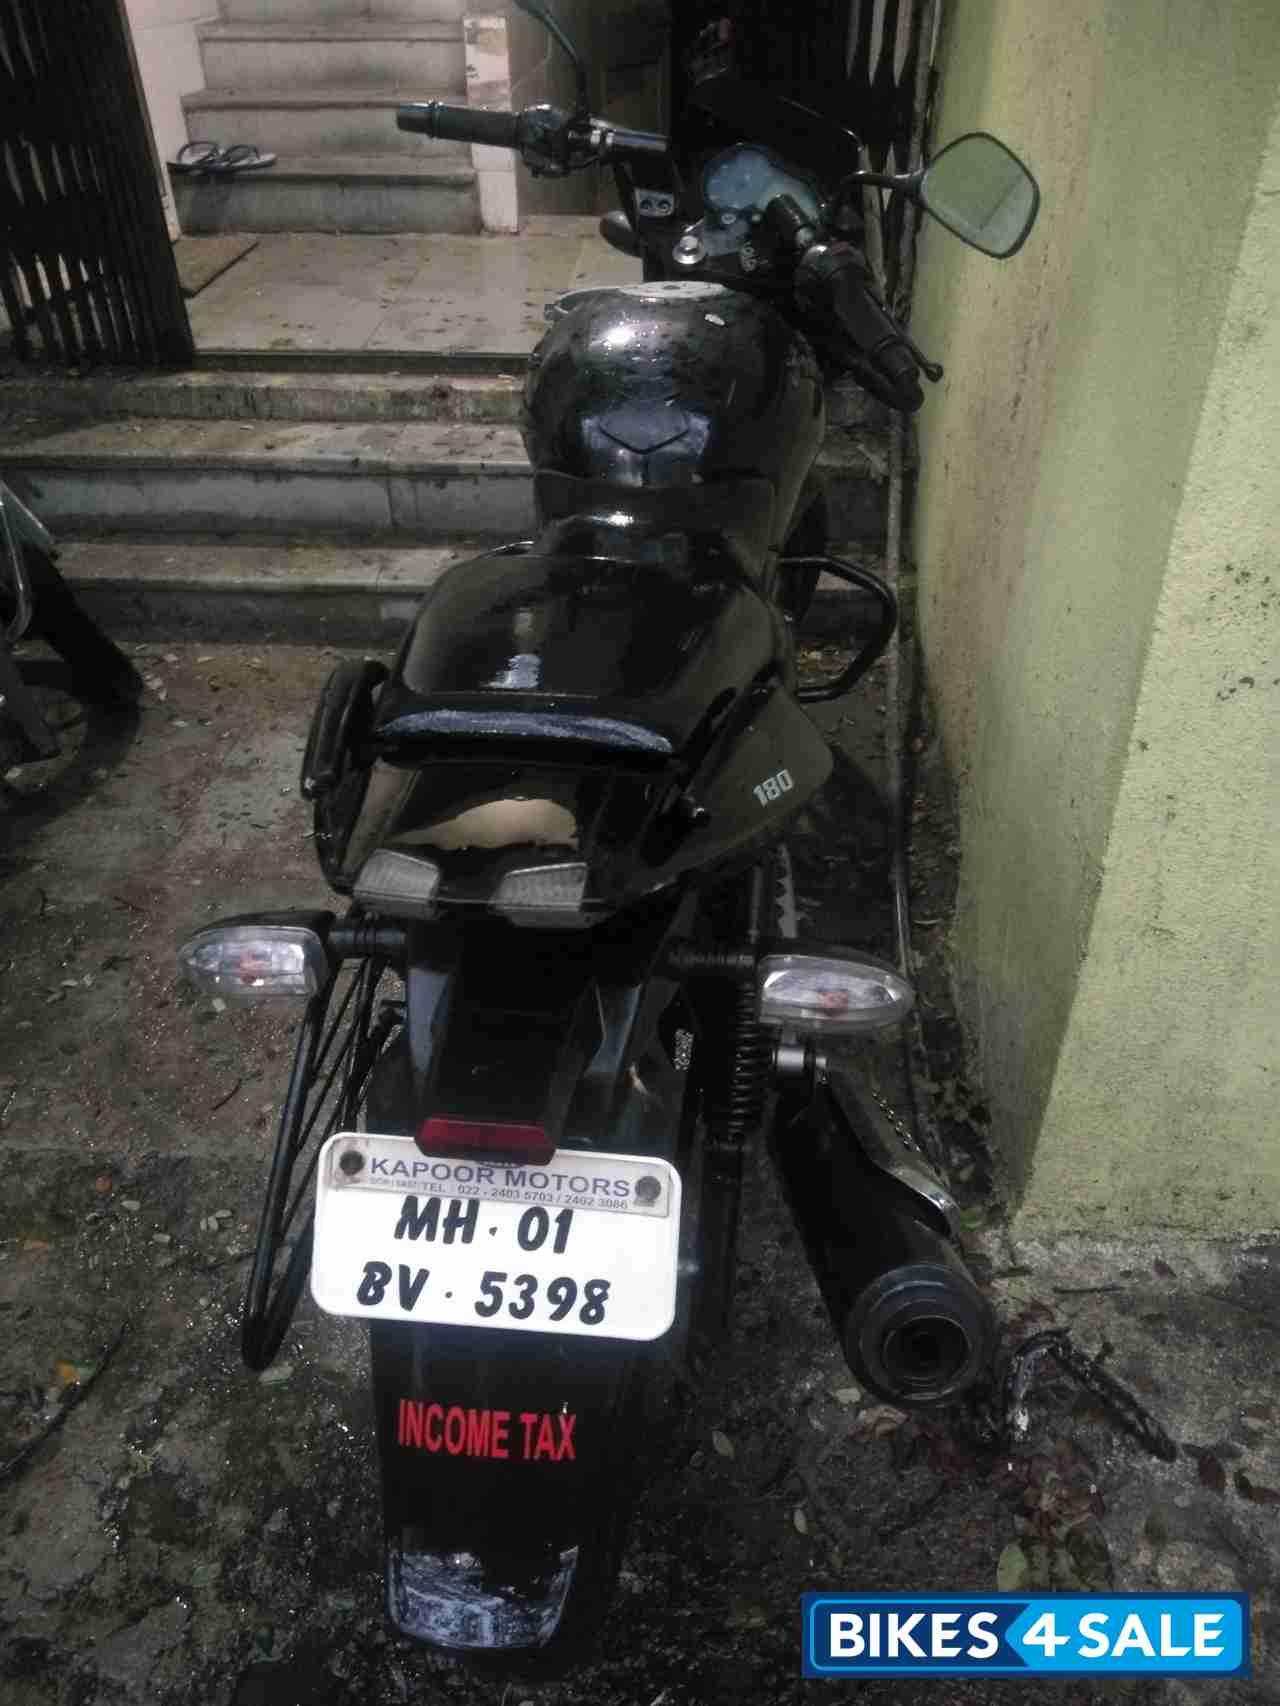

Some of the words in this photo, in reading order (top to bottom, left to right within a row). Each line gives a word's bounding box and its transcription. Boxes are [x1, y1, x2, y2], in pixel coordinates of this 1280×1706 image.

[753, 769, 793, 808] 180
[371, 1158, 495, 1184] KAPOOR
[505, 1170, 630, 1197] MOTORS
[394, 1195, 481, 1245] MH
[517, 1206, 575, 1254] 01
[356, 1260, 430, 1312] BV
[474, 1271, 611, 1326] 5398
[399, 1399, 510, 1459] INCOME
[520, 1412, 576, 1461] TAX
